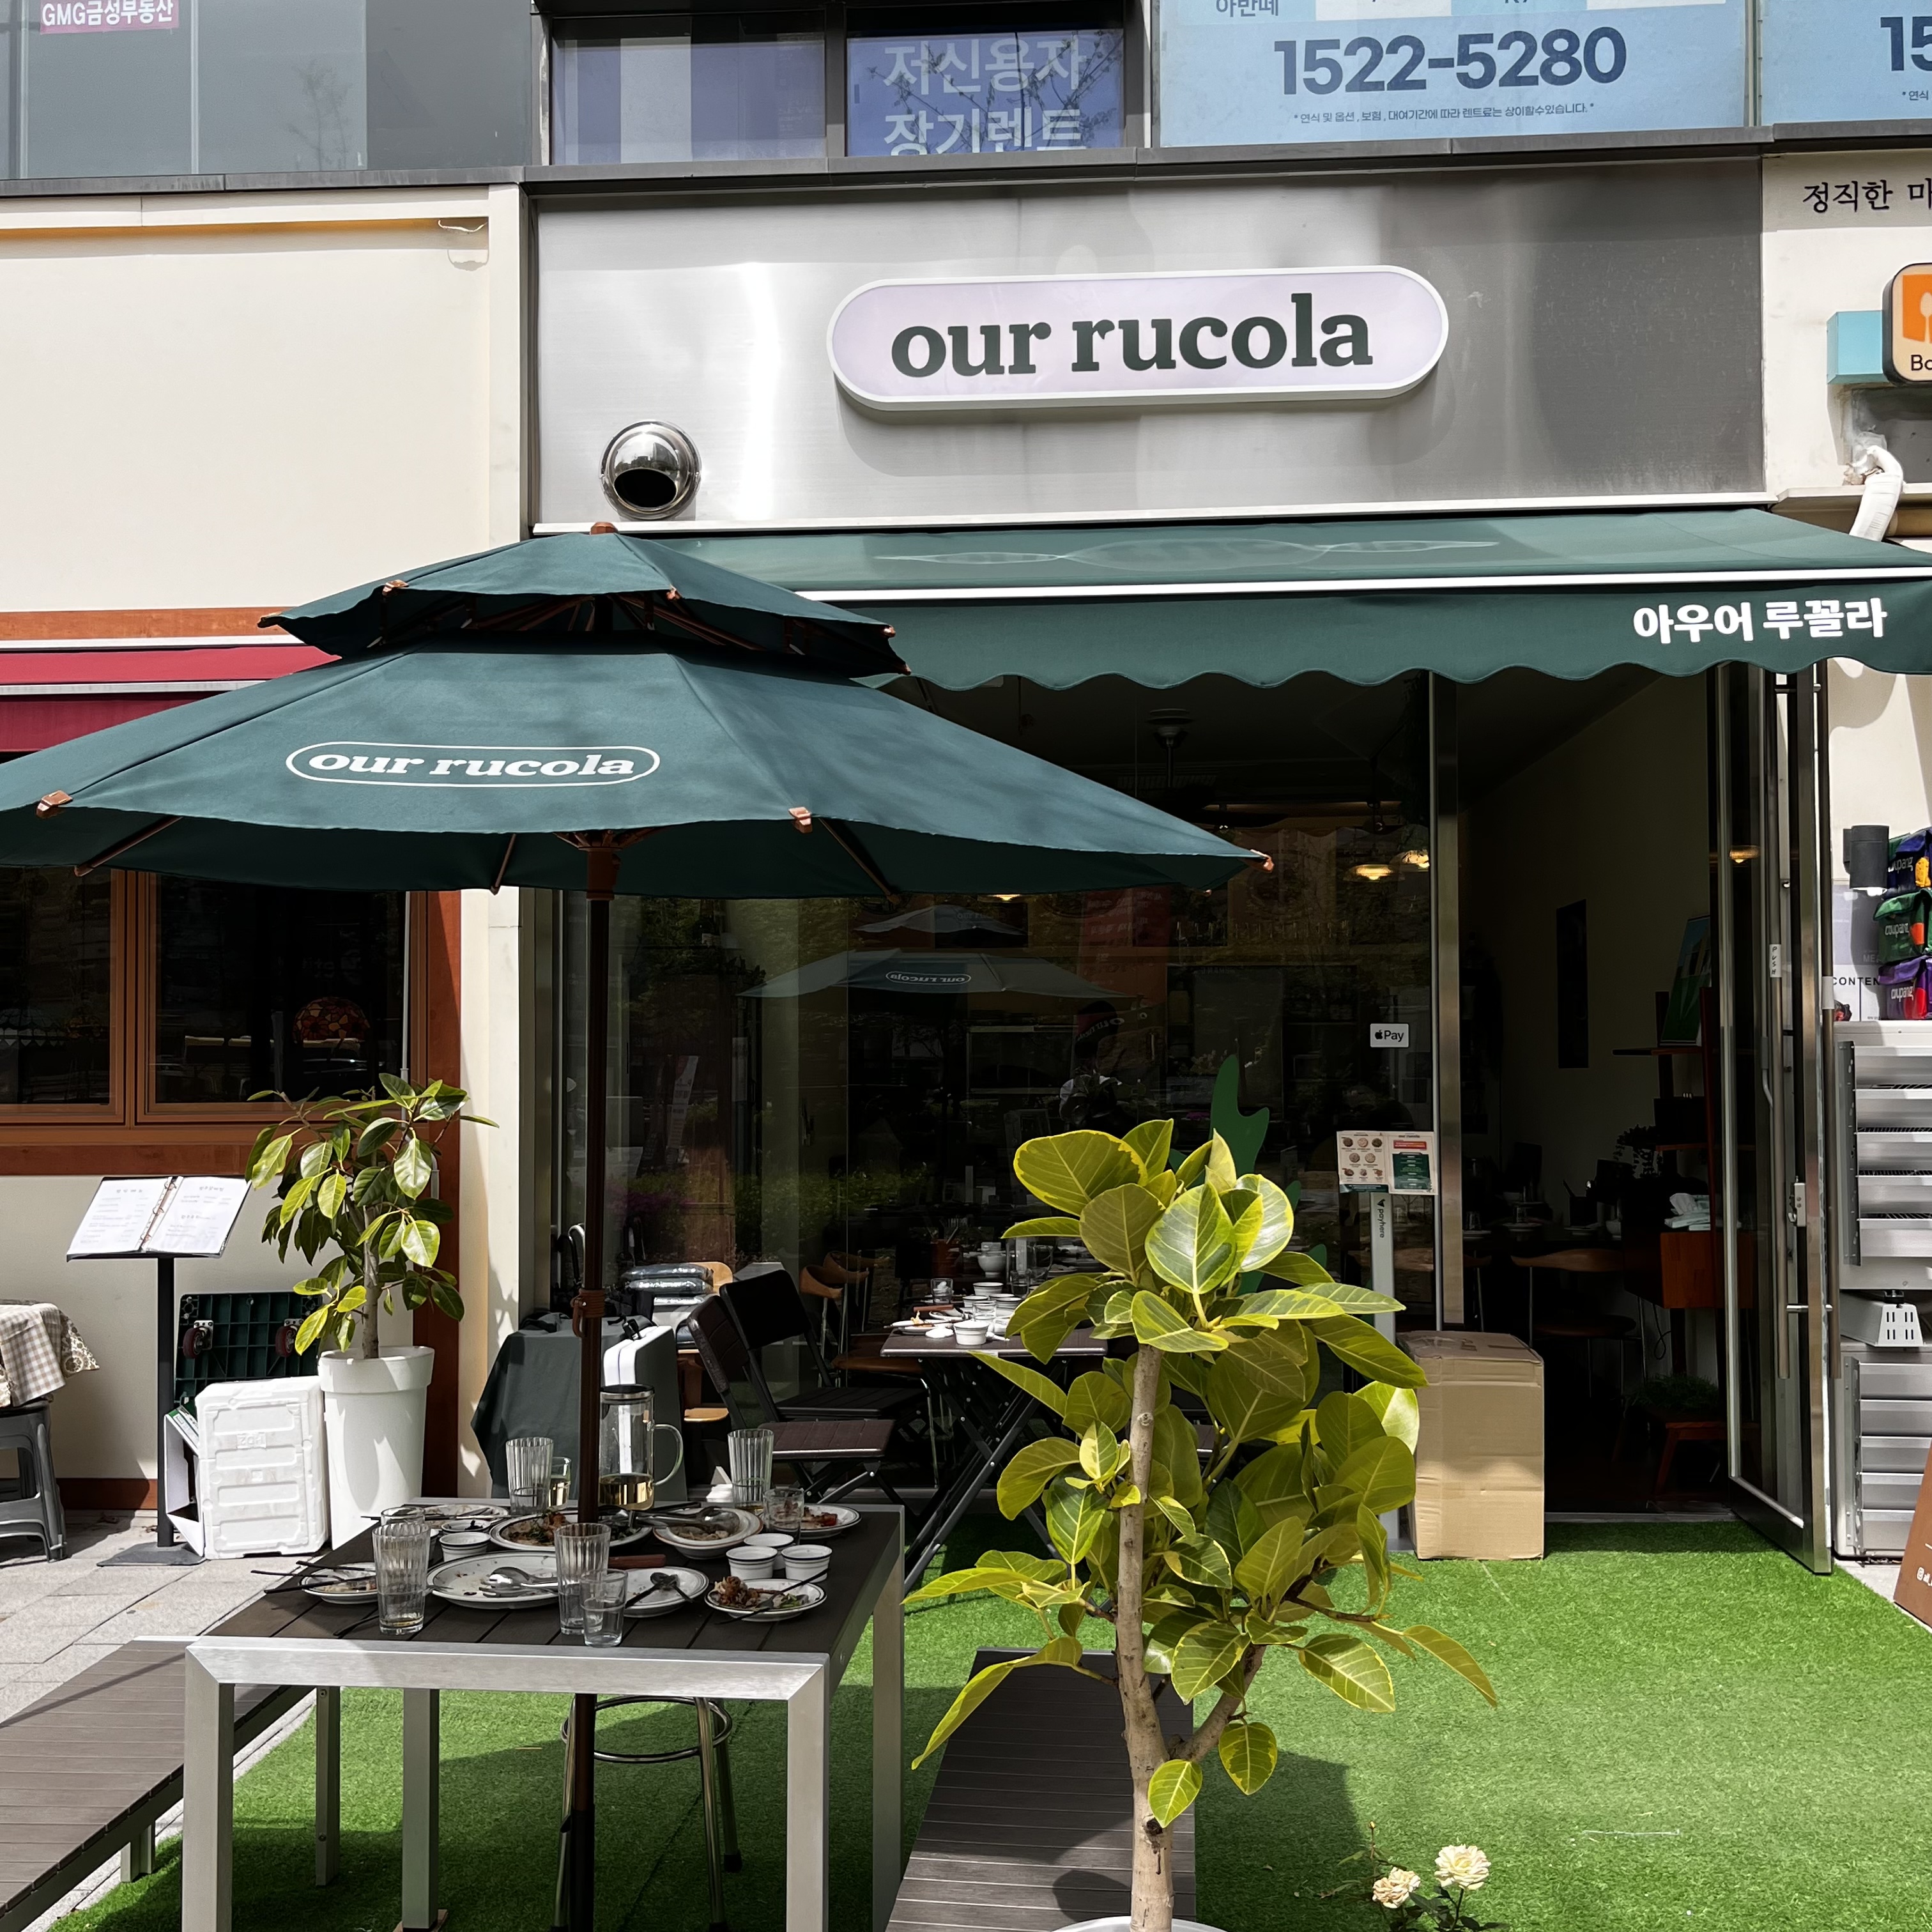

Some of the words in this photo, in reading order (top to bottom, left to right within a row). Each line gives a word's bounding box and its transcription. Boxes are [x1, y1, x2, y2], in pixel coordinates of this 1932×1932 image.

[42, 0, 173, 26] GMG금성부동산
[883, 33, 1087, 95] 저신용자
[1274, 27, 1627, 95] 1522-5280
[1908, 90, 1929, 100] 연식
[884, 106, 1087, 157] 장기렌트
[1300, 112, 1320, 124] 연식
[1322, 112, 1333, 123] 및
[1388, 109, 1438, 120] 대여기간에
[1440, 108, 1460, 119] 따라
[1462, 107, 1502, 118] 렌트료는
[1802, 179, 1894, 213] 정직한
[892, 321, 1052, 378] our
[1071, 293, 1373, 372] rucola
[1633, 602, 1754, 644] 아우어
[1763, 597, 1888, 640] 루꼴라
[309, 754, 425, 774] our
[429, 755, 635, 776] rucola
[1384, 1030, 1404, 1043] Pay
[1377, 1208, 1386, 1238] payhere
